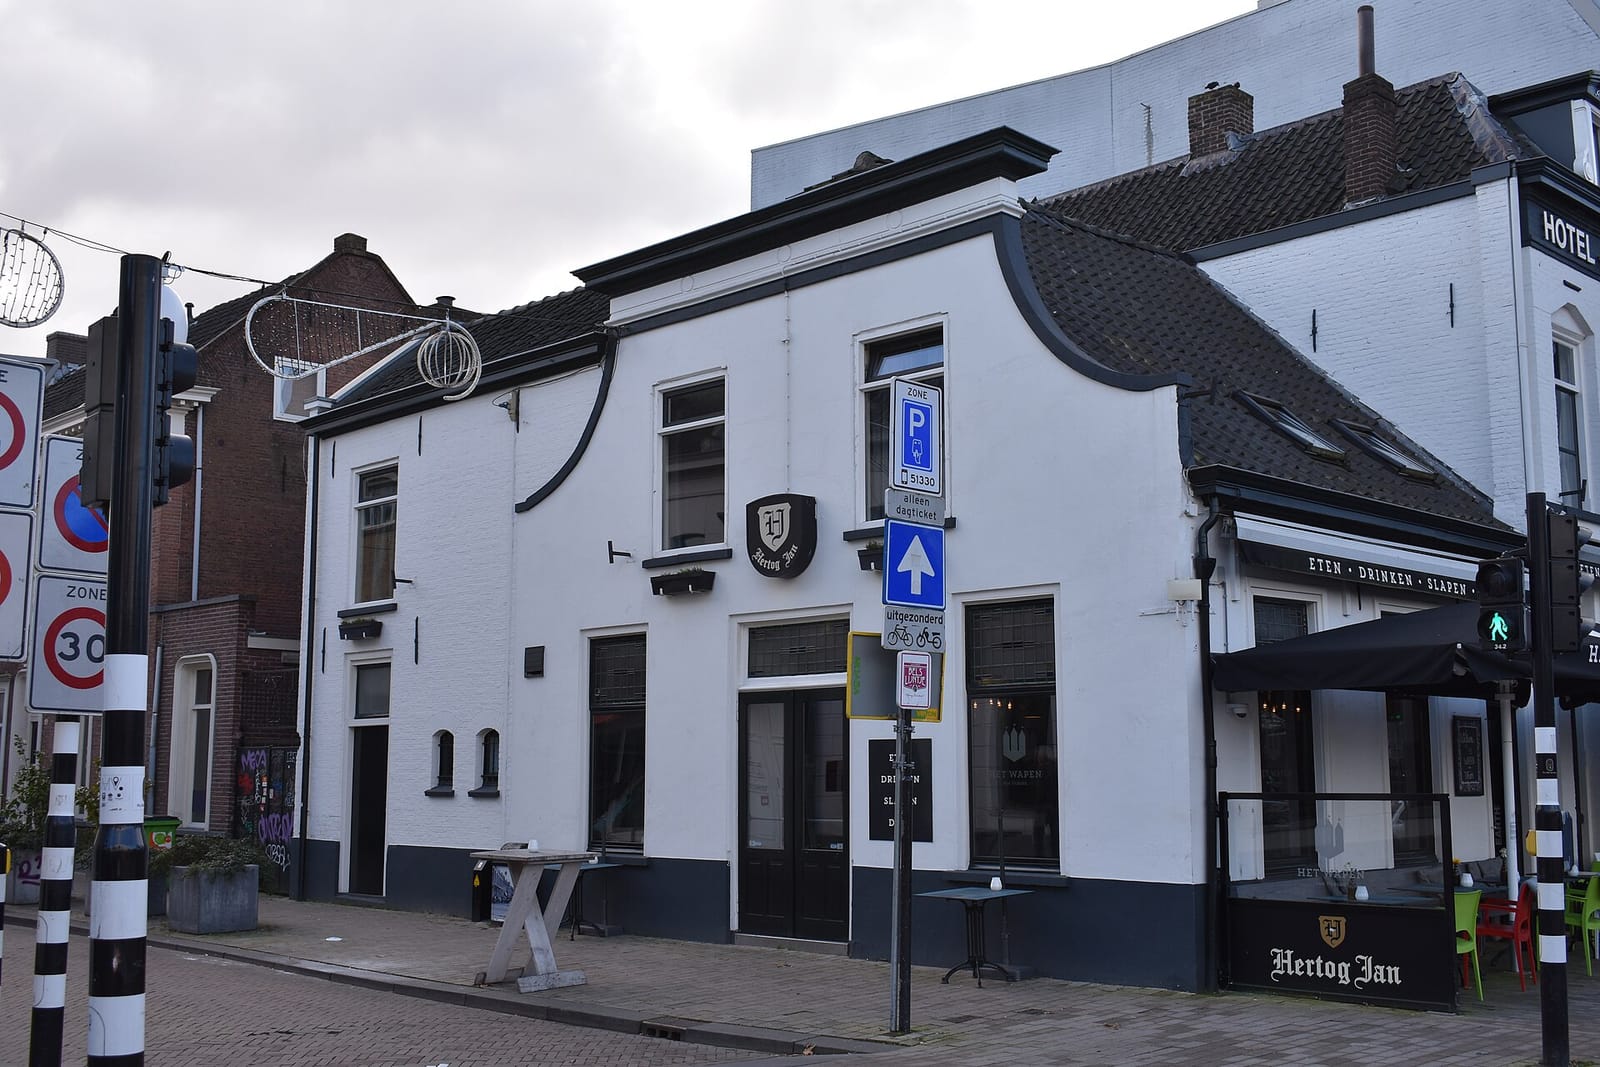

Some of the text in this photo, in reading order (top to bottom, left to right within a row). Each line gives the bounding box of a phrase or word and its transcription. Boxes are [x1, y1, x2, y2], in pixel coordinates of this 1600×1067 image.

[1543, 210, 1596, 265] HOTEL
[907, 387, 928, 400] ZONE
[909, 407, 925, 437] P
[910, 474, 935, 486] 51330
[903, 495, 930, 507] alleen
[896, 504, 937, 520] dagticket
[751, 543, 799, 571] Hertog Jan
[1308, 556, 1466, 595] ETEN DRINKEN SLAPEN
[66, 585, 107, 601] ZONE
[886, 610, 944, 625] uitgezonderd
[58, 632, 105, 664] 30
[1009, 770, 1042, 779] WAPEN
[1297, 867, 1320, 878] HET
[1270, 947, 1402, 990] Hertog Jan
